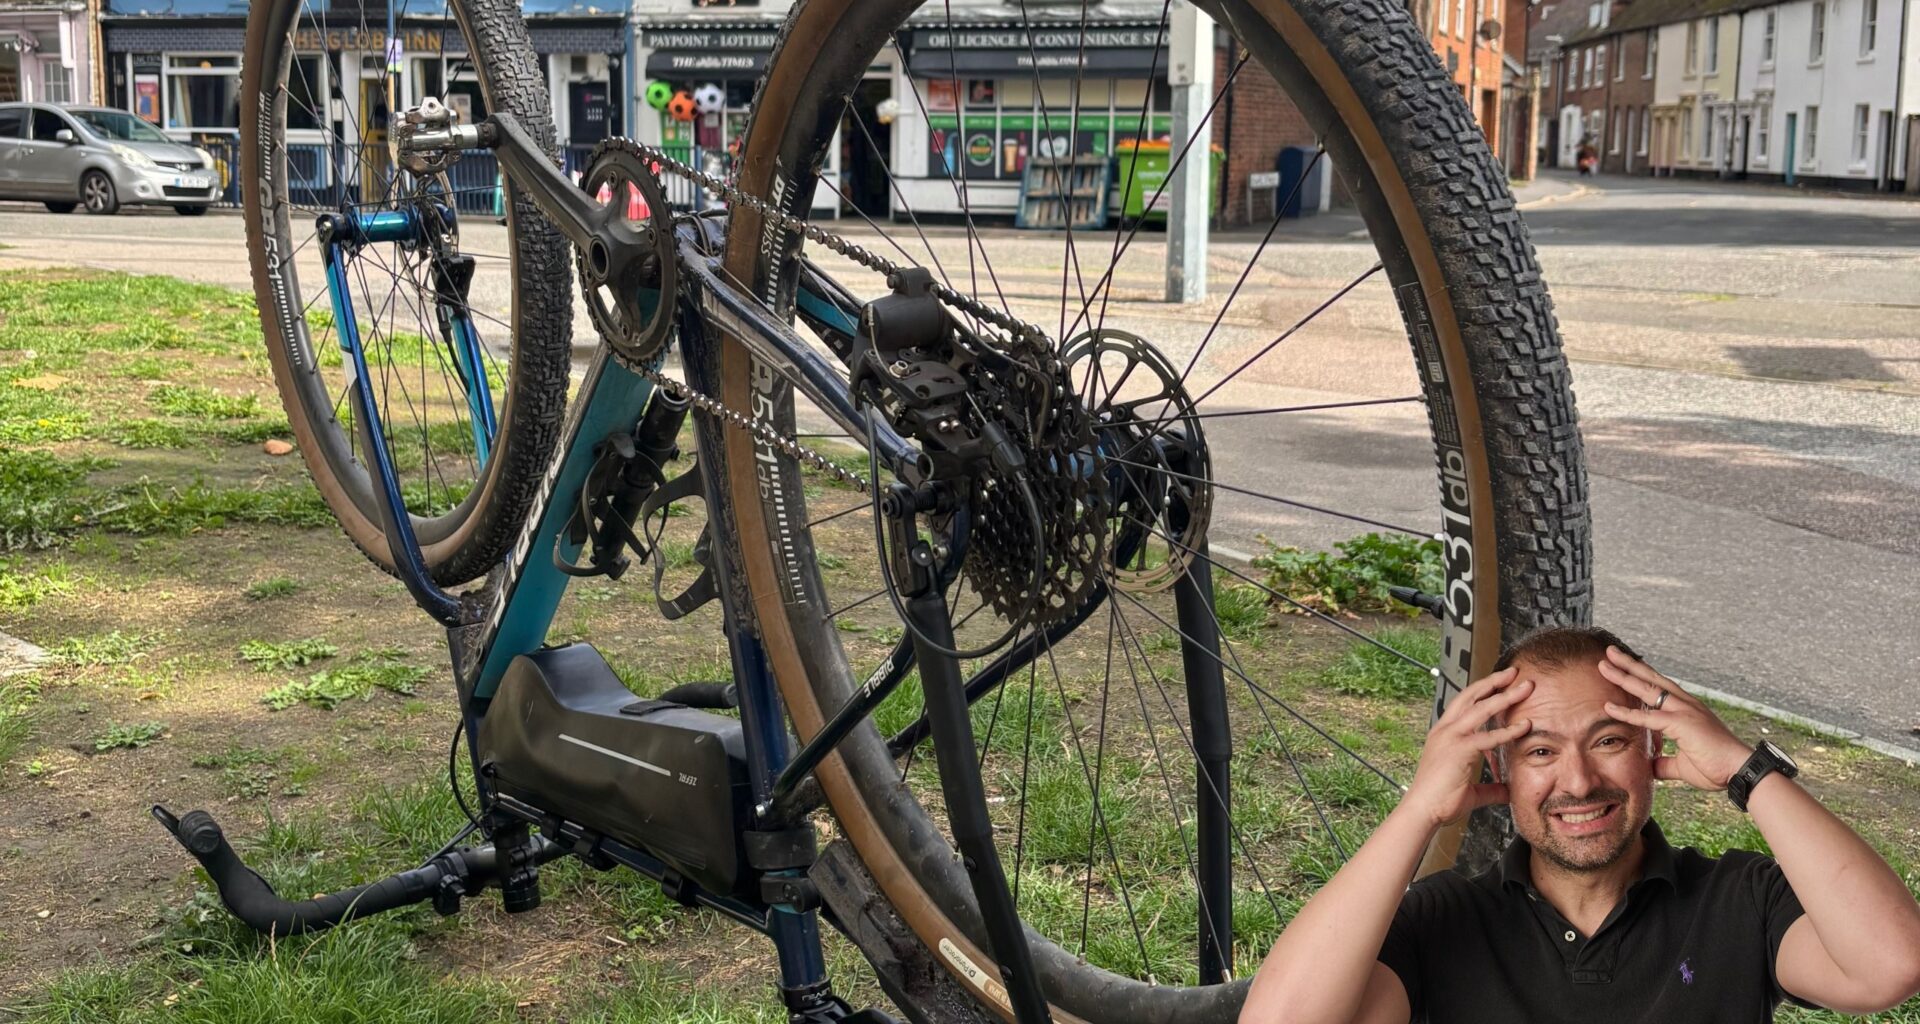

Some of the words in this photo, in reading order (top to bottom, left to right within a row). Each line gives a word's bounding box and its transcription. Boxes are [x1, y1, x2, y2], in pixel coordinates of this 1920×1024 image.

[327, 31, 385, 50] GLOB
[404, 31, 441, 52] INN
[650, 34, 710, 47] PAYPOINT
[720, 34, 779, 47] LOTTERY
[959, 33, 1017, 48] LICENCE
[1035, 31, 1139, 47] CONVENIENCE
[1143, 31, 1170, 45] STO
[258, 91, 266, 113] DT
[257, 112, 265, 147] SWISS
[771, 173, 786, 208] DT
[863, 655, 895, 699] RIBBLE
